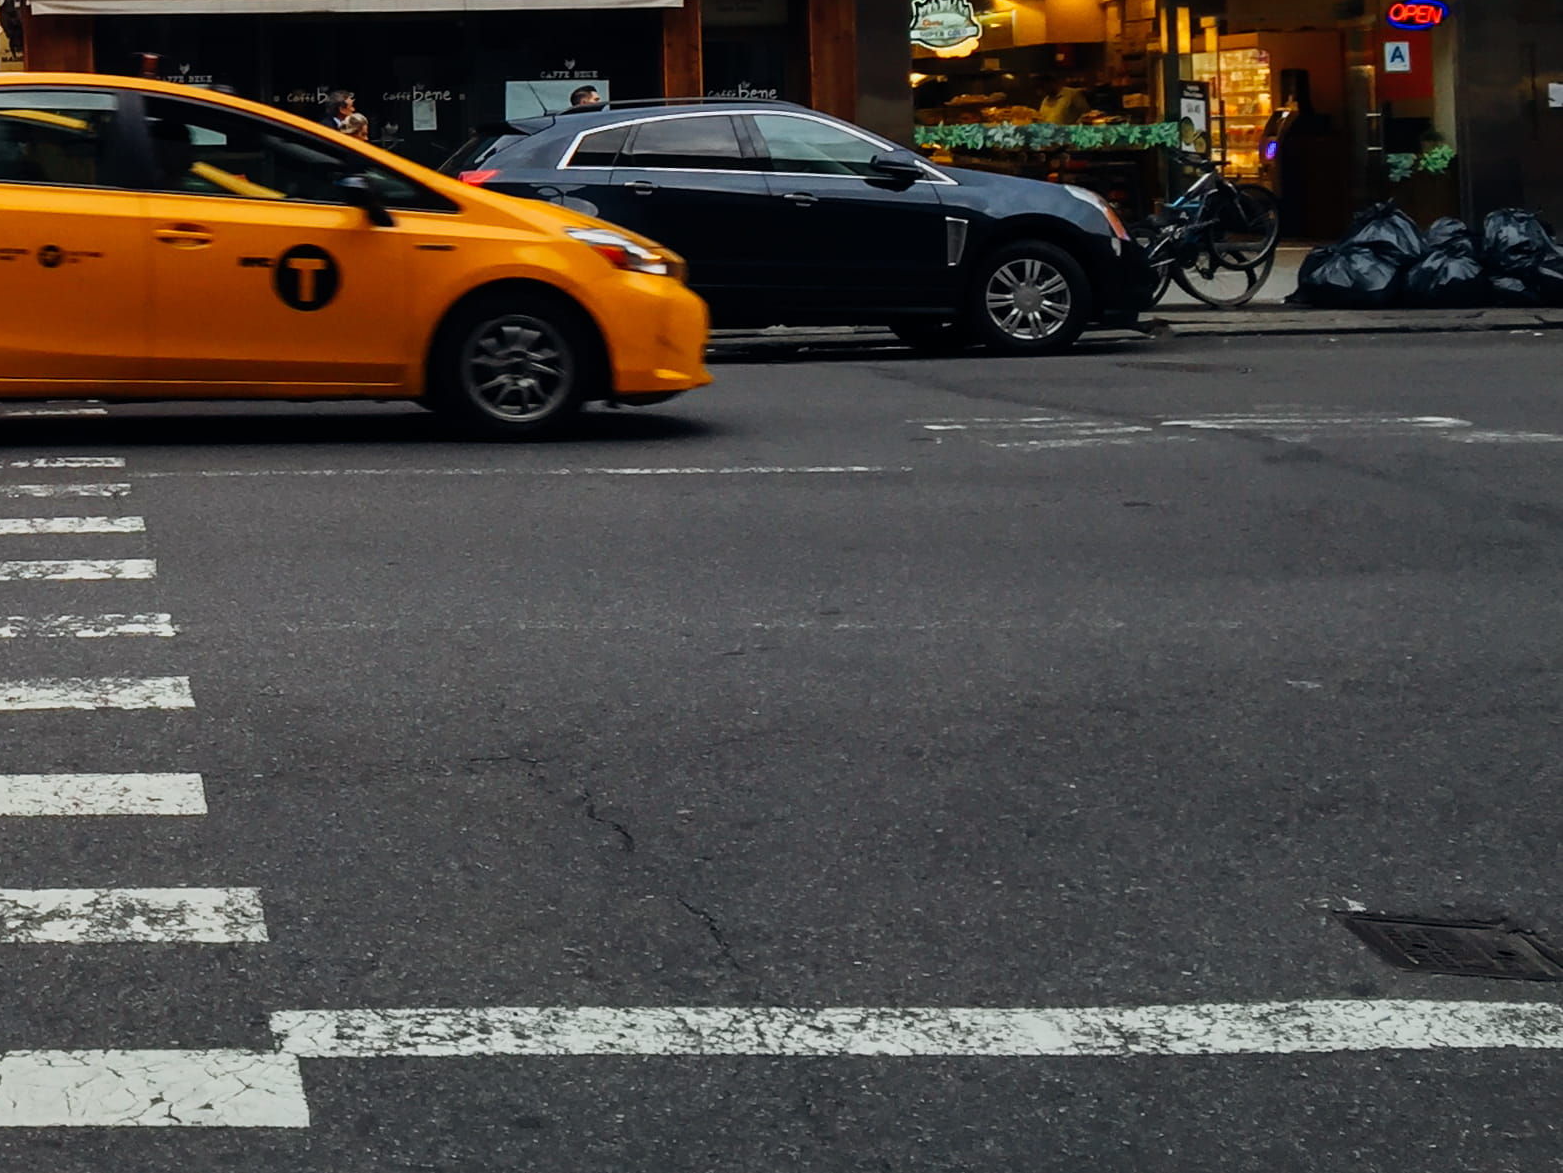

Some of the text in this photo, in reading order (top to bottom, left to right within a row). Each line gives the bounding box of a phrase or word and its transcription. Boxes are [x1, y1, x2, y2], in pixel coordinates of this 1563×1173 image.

[1388, 2, 1443, 25] OPEN
[1389, 45, 1406, 64] A
[286, 257, 327, 303] T
